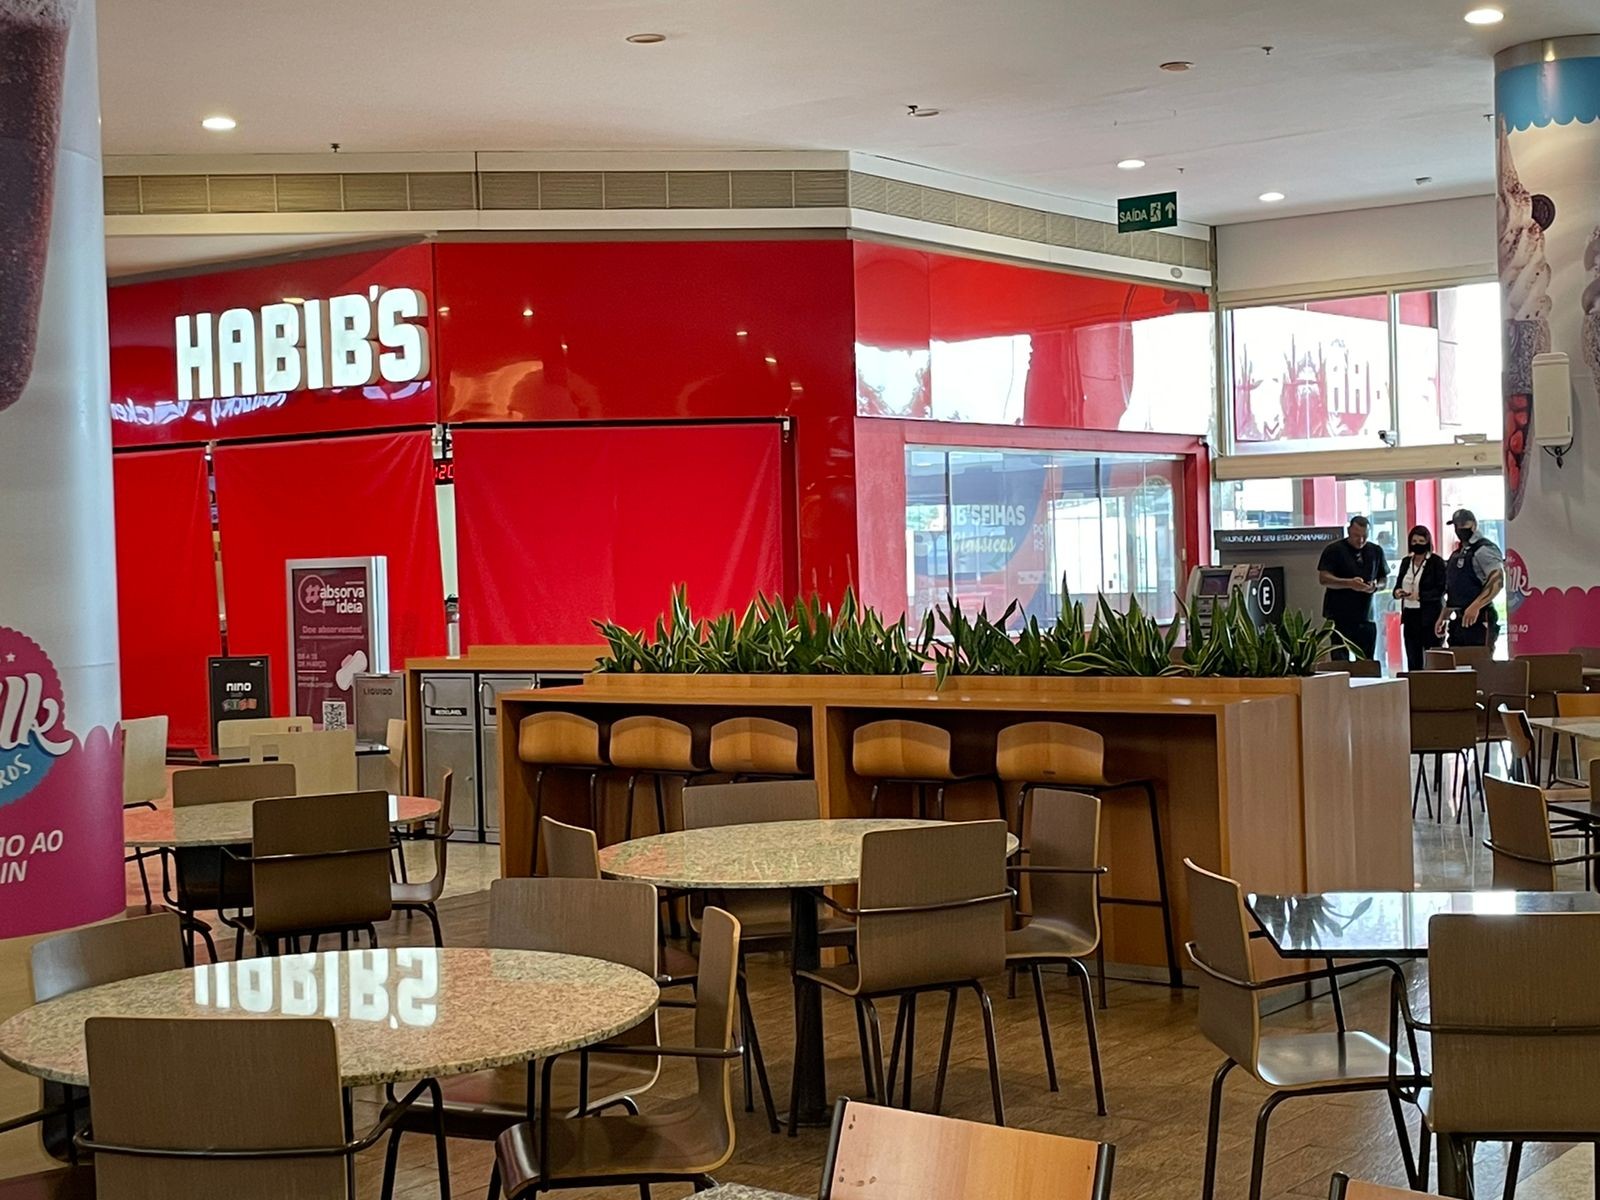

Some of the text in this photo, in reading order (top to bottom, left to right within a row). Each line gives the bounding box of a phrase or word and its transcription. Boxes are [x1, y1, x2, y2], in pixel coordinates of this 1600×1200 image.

[1119, 208, 1148, 223] SAÍDA
[175, 285, 424, 400] HABIB'S
[1262, 586, 1271, 605] E
[336, 598, 364, 614] ideia
[225, 681, 253, 693] nino
[29, 829, 64, 854] AO
[0, 859, 28, 885] IN
